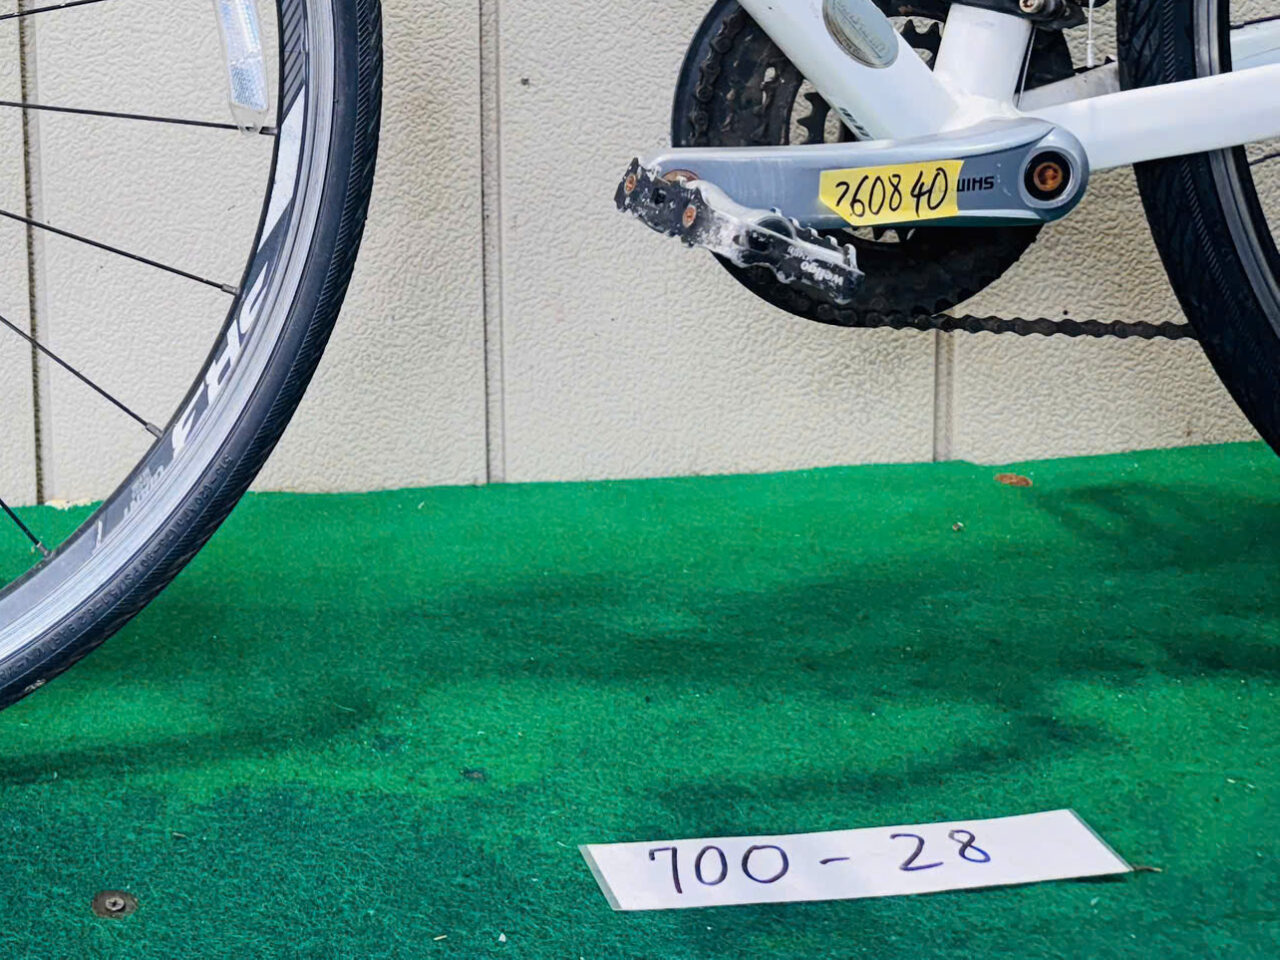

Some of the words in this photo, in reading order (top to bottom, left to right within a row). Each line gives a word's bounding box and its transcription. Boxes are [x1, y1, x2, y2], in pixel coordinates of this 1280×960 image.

[957, 176, 994, 192] SHIM
[648, 844, 790, 894] 700
[889, 828, 991, 873] 28
